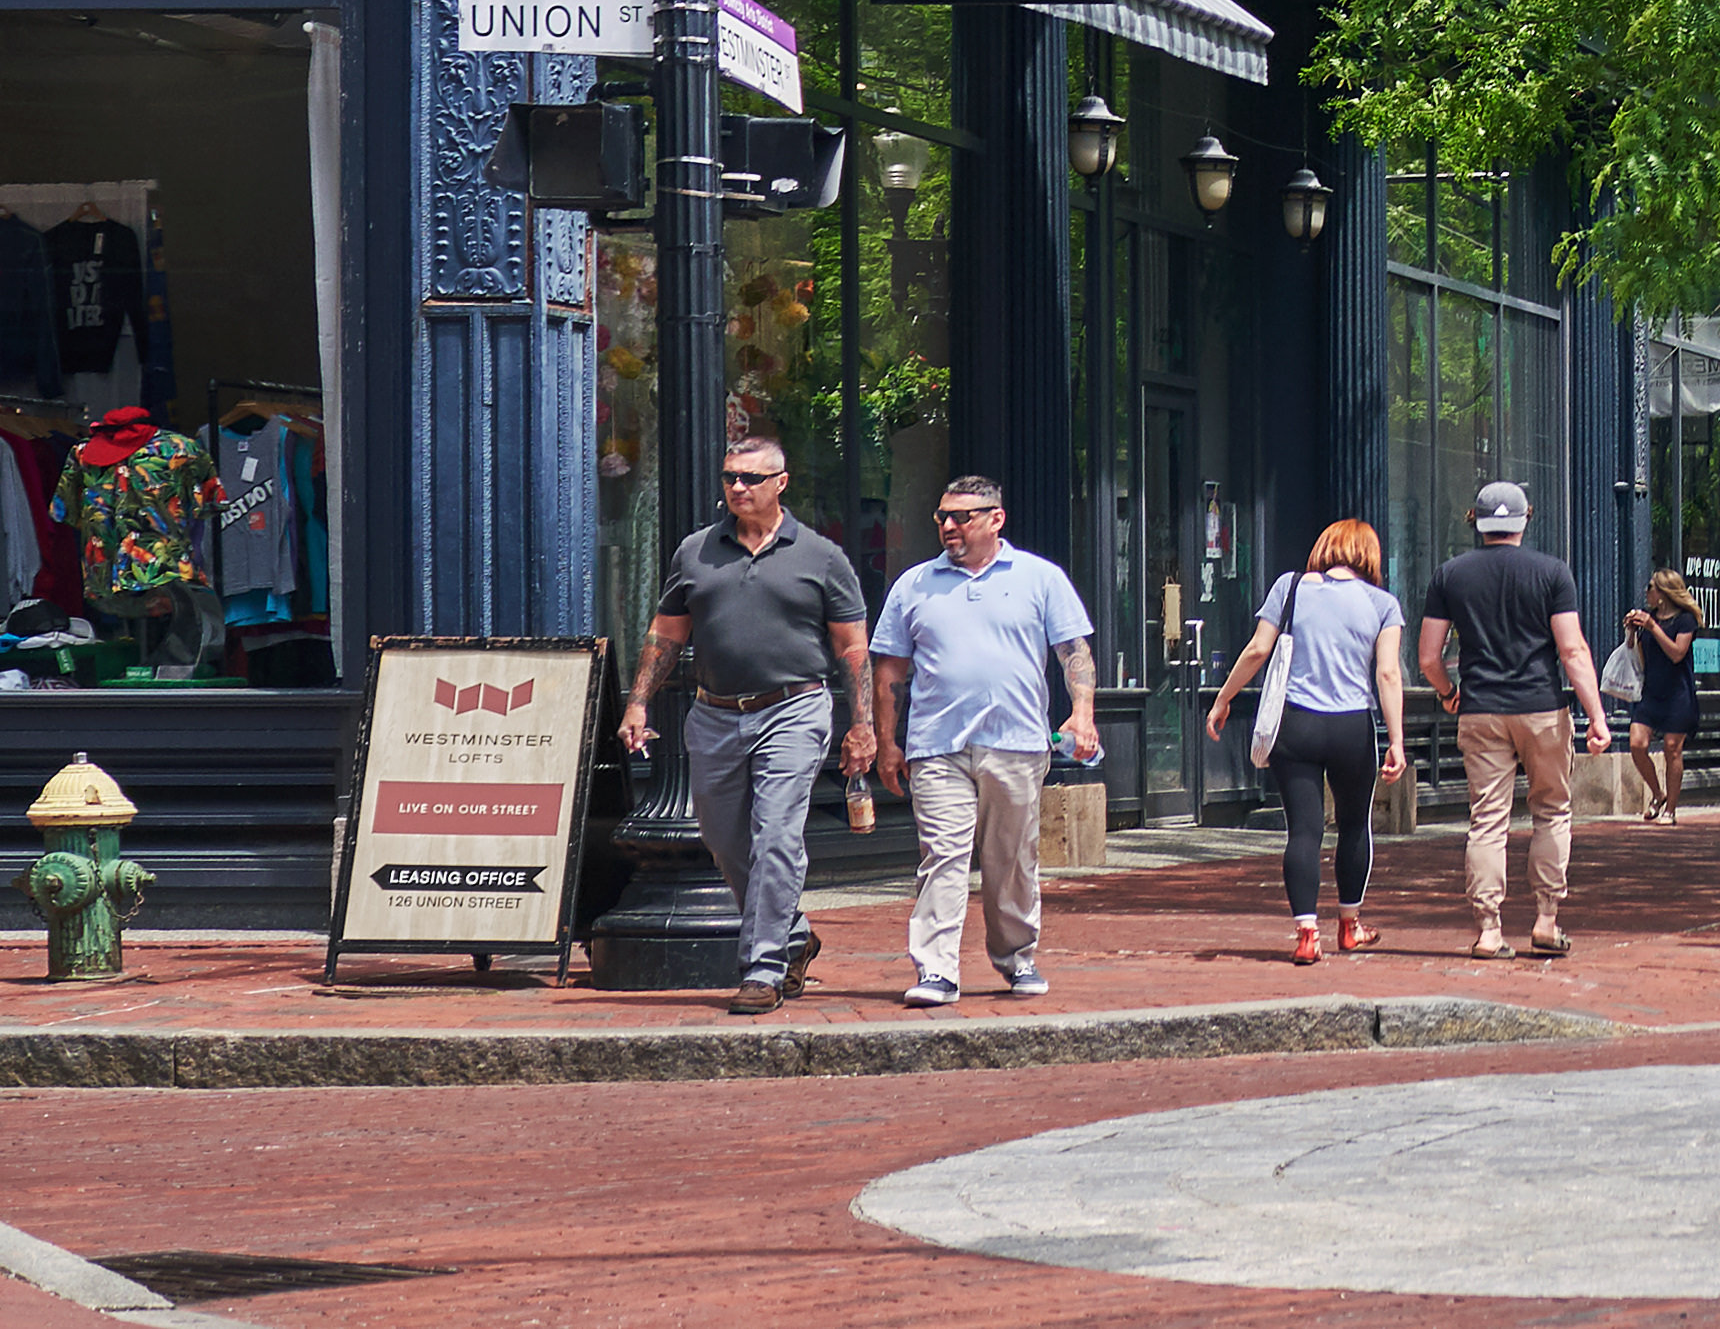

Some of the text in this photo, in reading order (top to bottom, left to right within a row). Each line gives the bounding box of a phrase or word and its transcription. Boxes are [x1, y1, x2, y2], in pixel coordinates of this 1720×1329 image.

[472, 4, 643, 38] UNION ST
[720, 25, 785, 90] ESTMINSTER
[1685, 556, 1720, 579] we are
[404, 732, 553, 747] WESTMINSTER
[448, 753, 504, 764] LOFTS
[399, 802, 538, 816] LIVE ON OUR STREET
[389, 869, 527, 886] LEASING OFFICE
[388, 895, 523, 910] 126 UNION STREET
